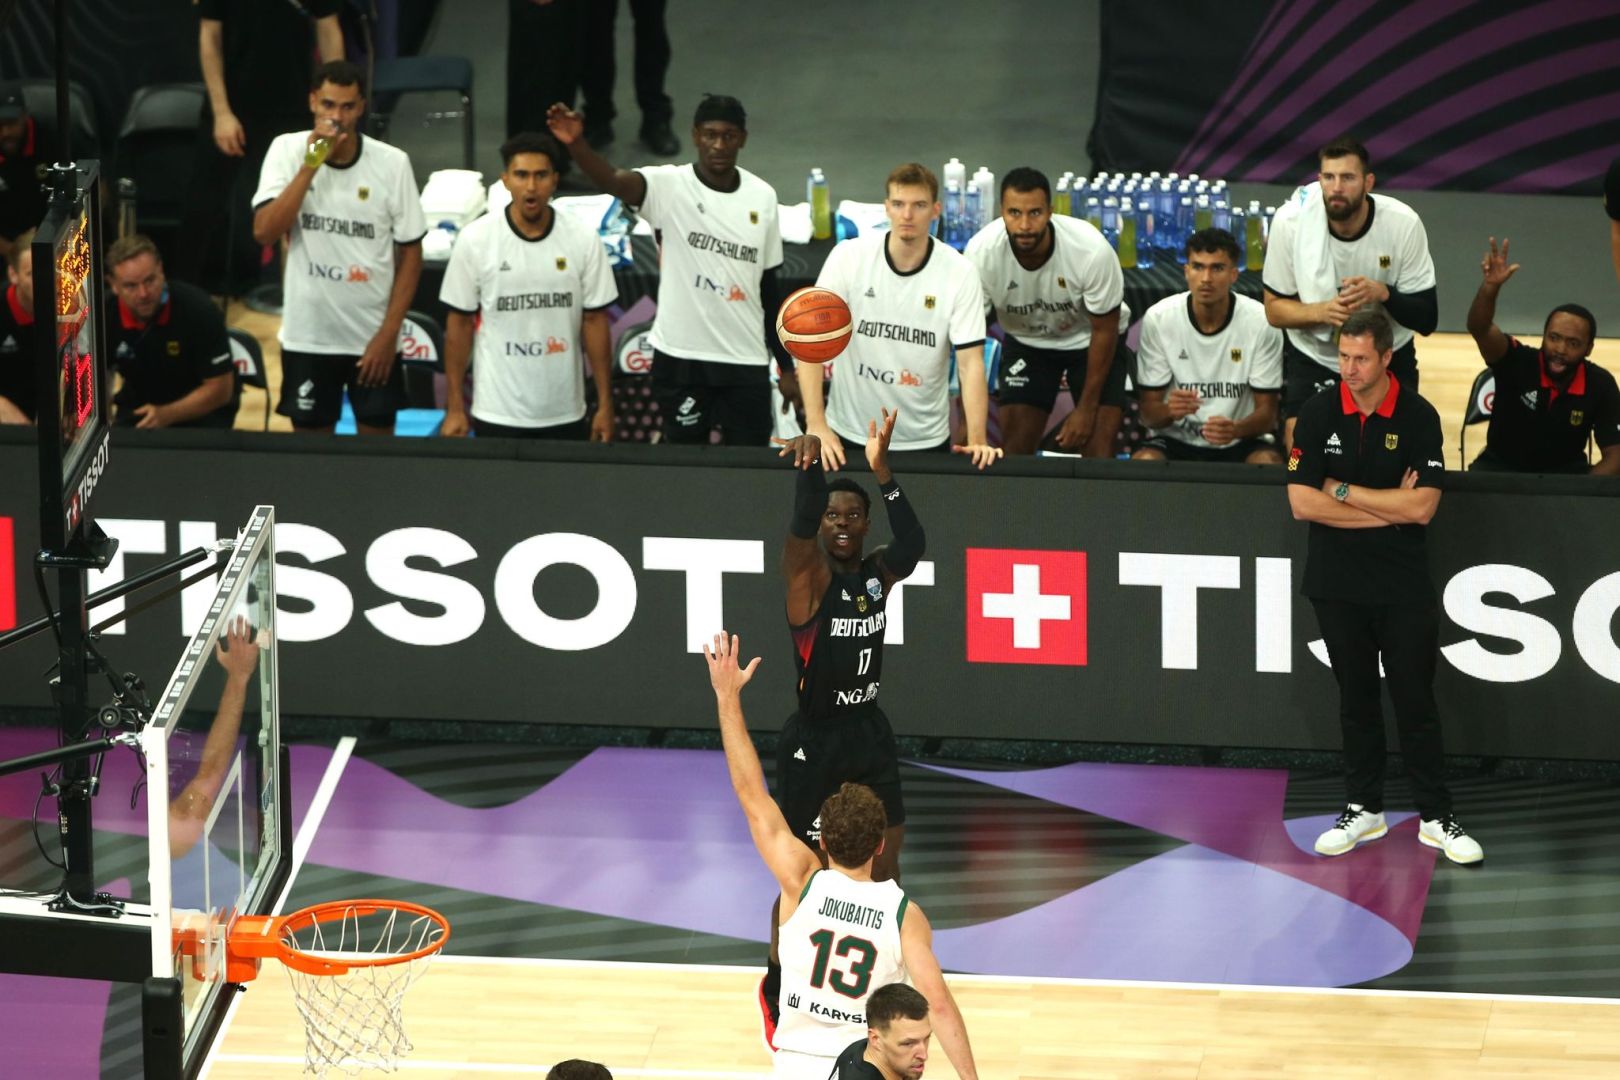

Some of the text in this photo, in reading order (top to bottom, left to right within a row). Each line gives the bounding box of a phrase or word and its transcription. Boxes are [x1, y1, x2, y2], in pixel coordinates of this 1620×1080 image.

[302, 213, 375, 239] DEUTSCHLAND
[687, 231, 759, 263] DEUTSCHLAND
[309, 262, 343, 281] ING
[694, 275, 724, 296] IN
[496, 291, 573, 311] DEUTSCHLAND
[857, 319, 937, 348] DEUTSCHLAND
[505, 341, 543, 357] ING
[857, 363, 895, 385] ING
[78, 431, 110, 512] TISSOT
[86, 518, 765, 652] TISSOT
[1119, 551, 1620, 684] TIS
[857, 647, 872, 676] 17
[833, 688, 863, 705] NG
[818, 896, 885, 930] JOKUBAITIS
[809, 928, 879, 1000] 13
[809, 1001, 867, 1024] KARYS.
